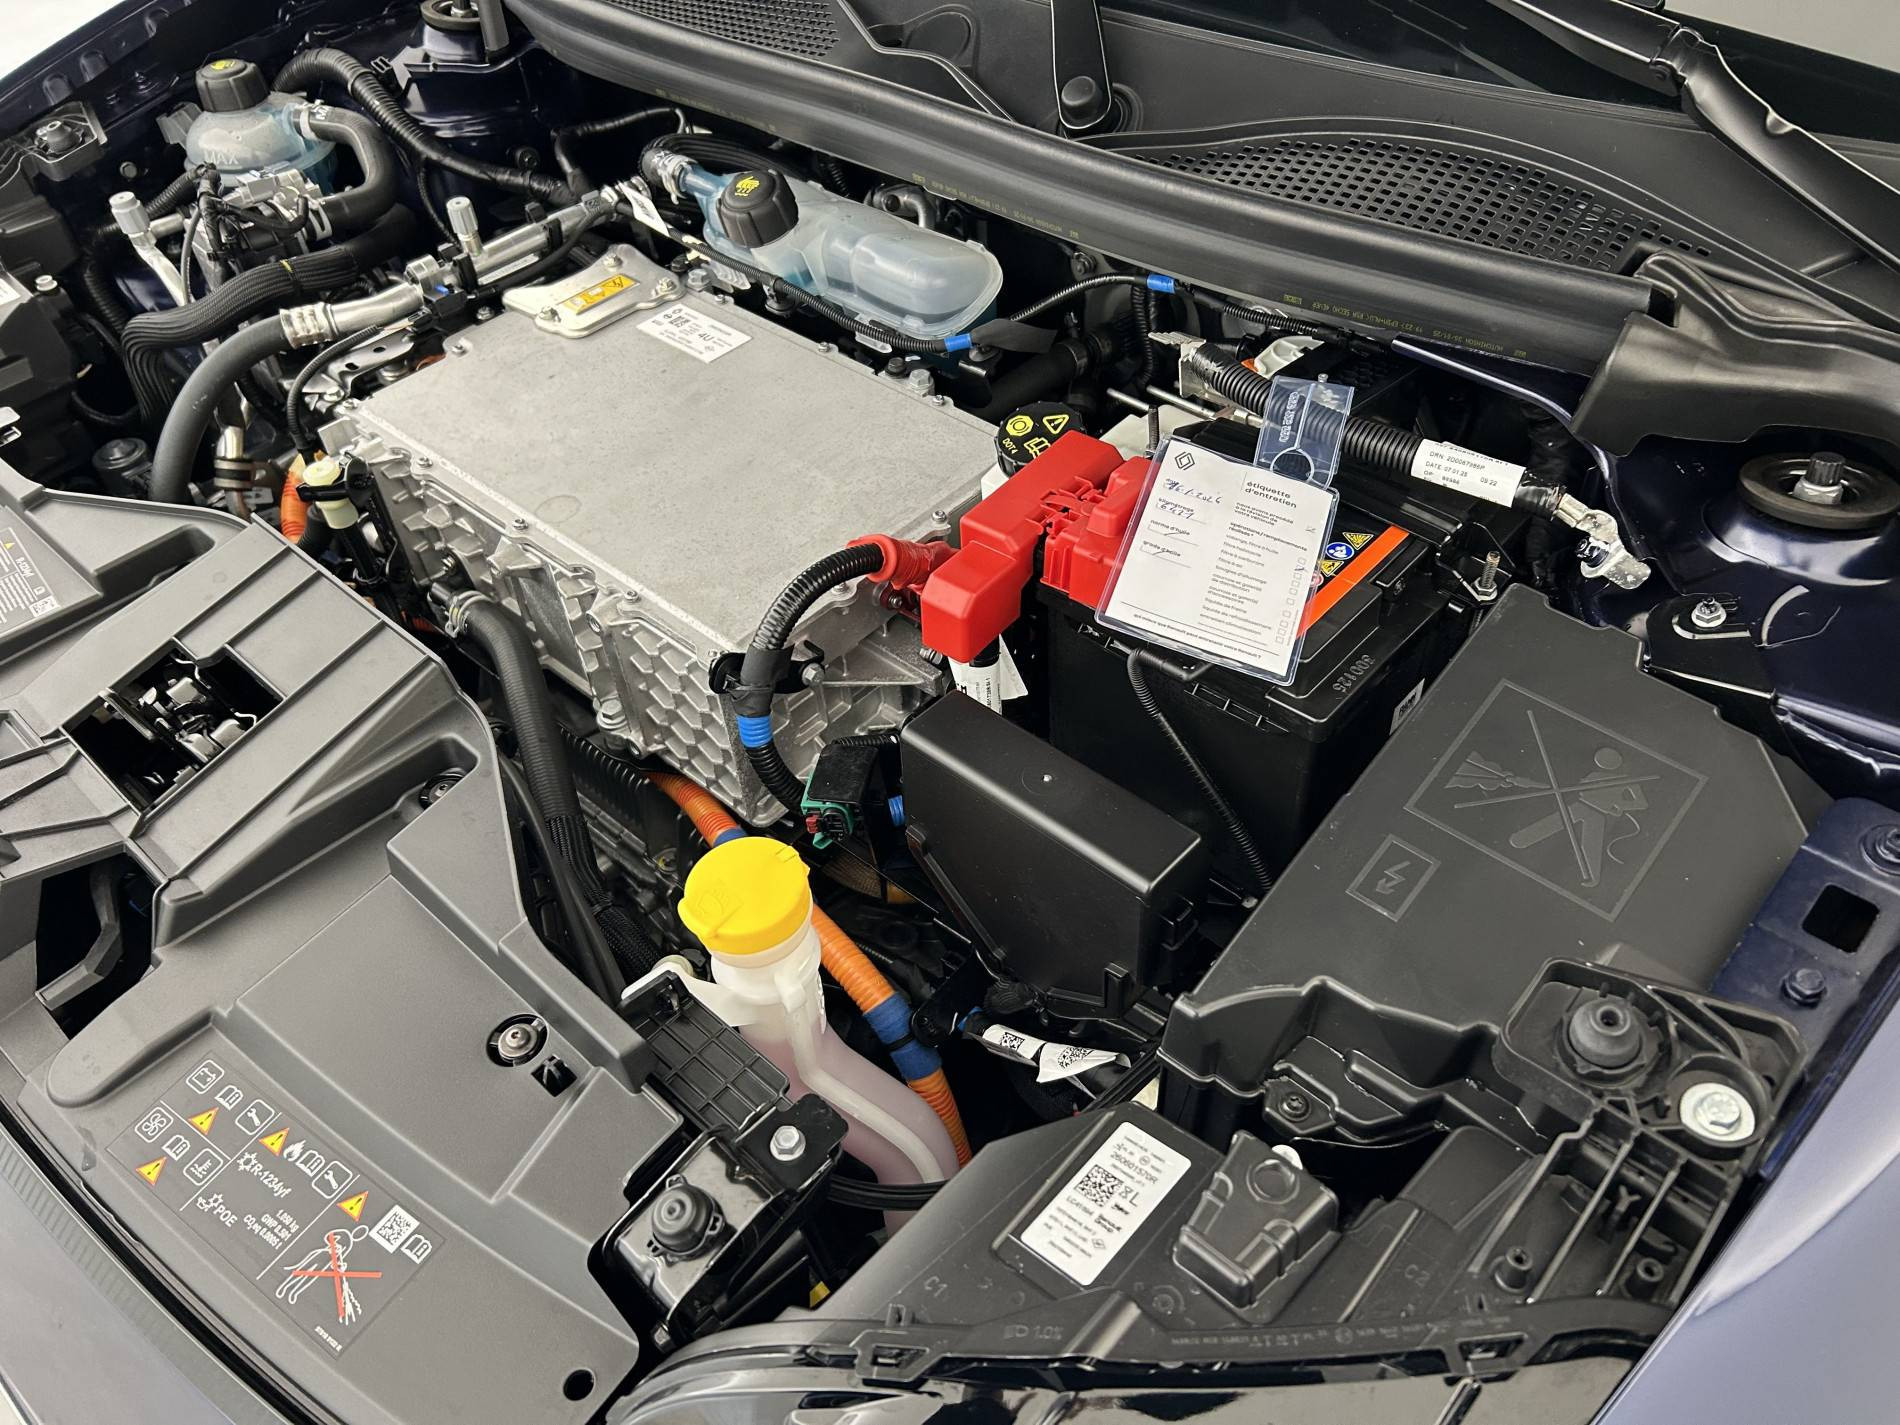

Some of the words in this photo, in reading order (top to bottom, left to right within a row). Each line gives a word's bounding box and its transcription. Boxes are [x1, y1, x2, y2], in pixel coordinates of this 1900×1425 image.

[697, 331, 714, 343] 4U
[1244, 488, 1297, 508] d'entretien
[1246, 481, 1291, 499] étiquette
[250, 1163, 292, 1198] R-1234yf
[213, 1204, 238, 1227] POE
